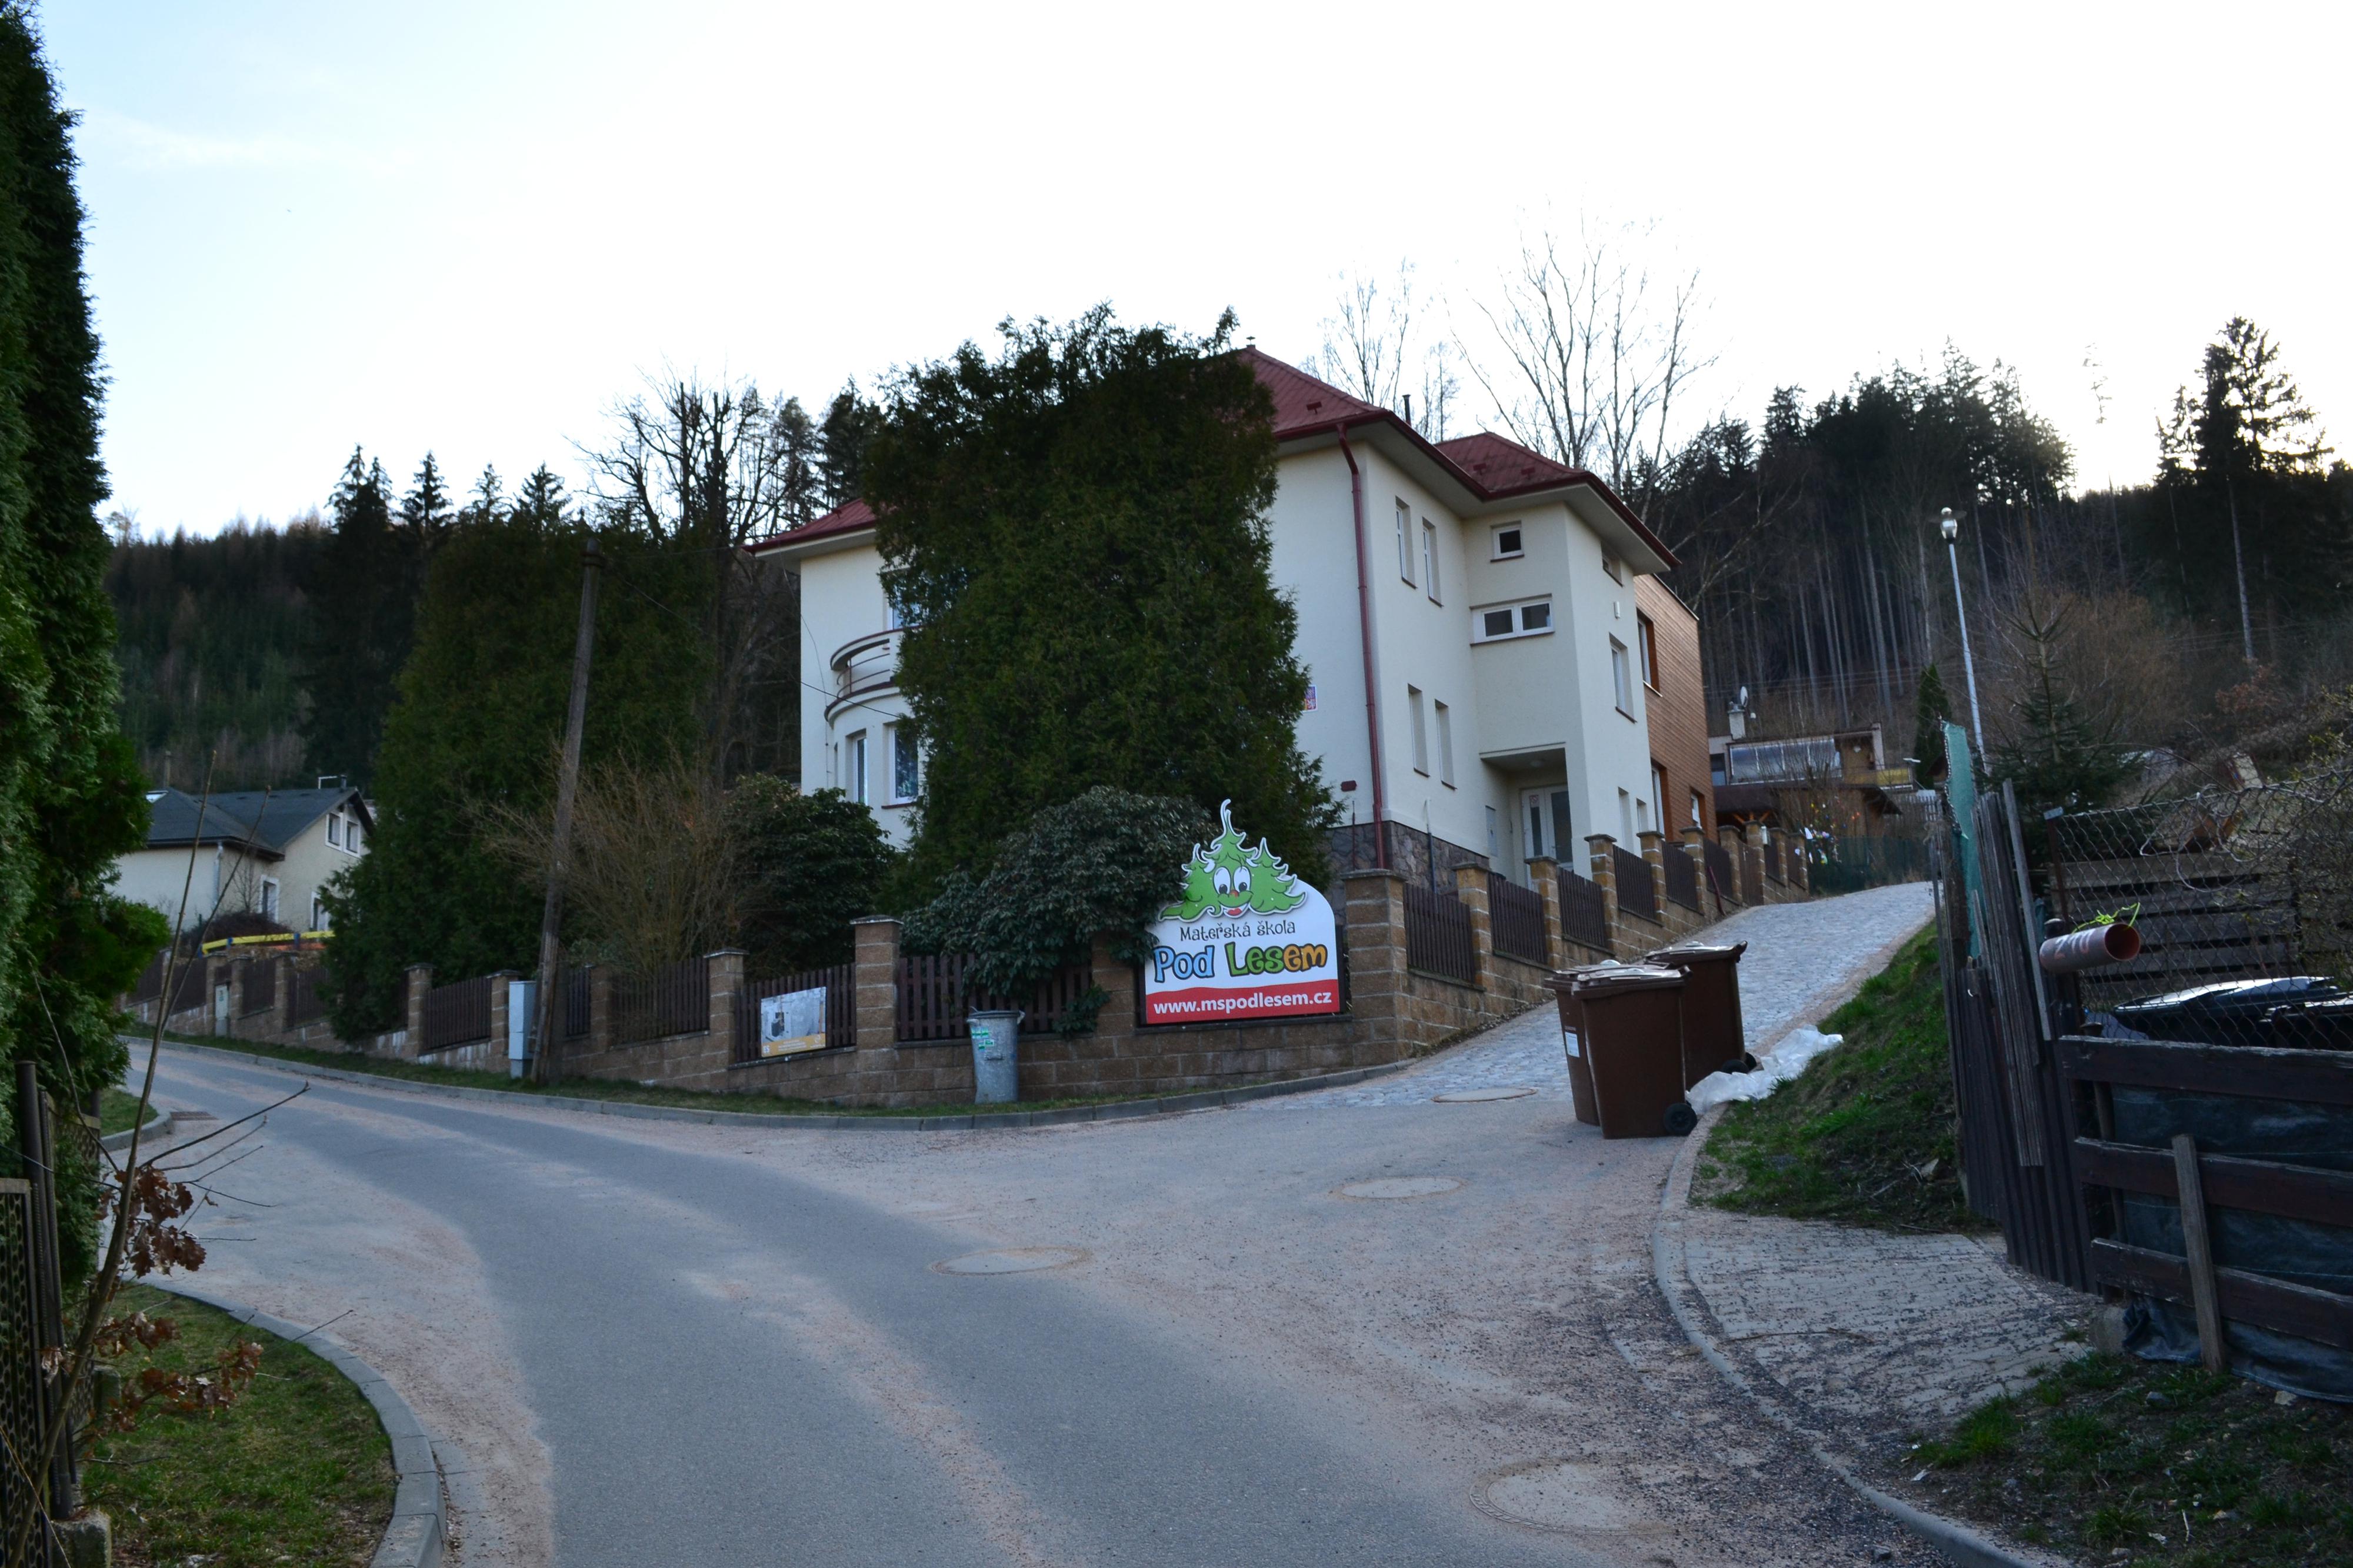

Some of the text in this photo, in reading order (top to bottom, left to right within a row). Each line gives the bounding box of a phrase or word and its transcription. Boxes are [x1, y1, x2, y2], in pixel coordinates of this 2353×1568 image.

[1180, 920, 1295, 940] Mateřská škola
[1153, 941, 1328, 983] Pod Lesem
[1154, 992, 1332, 1013] www.mspodlesem.cz
